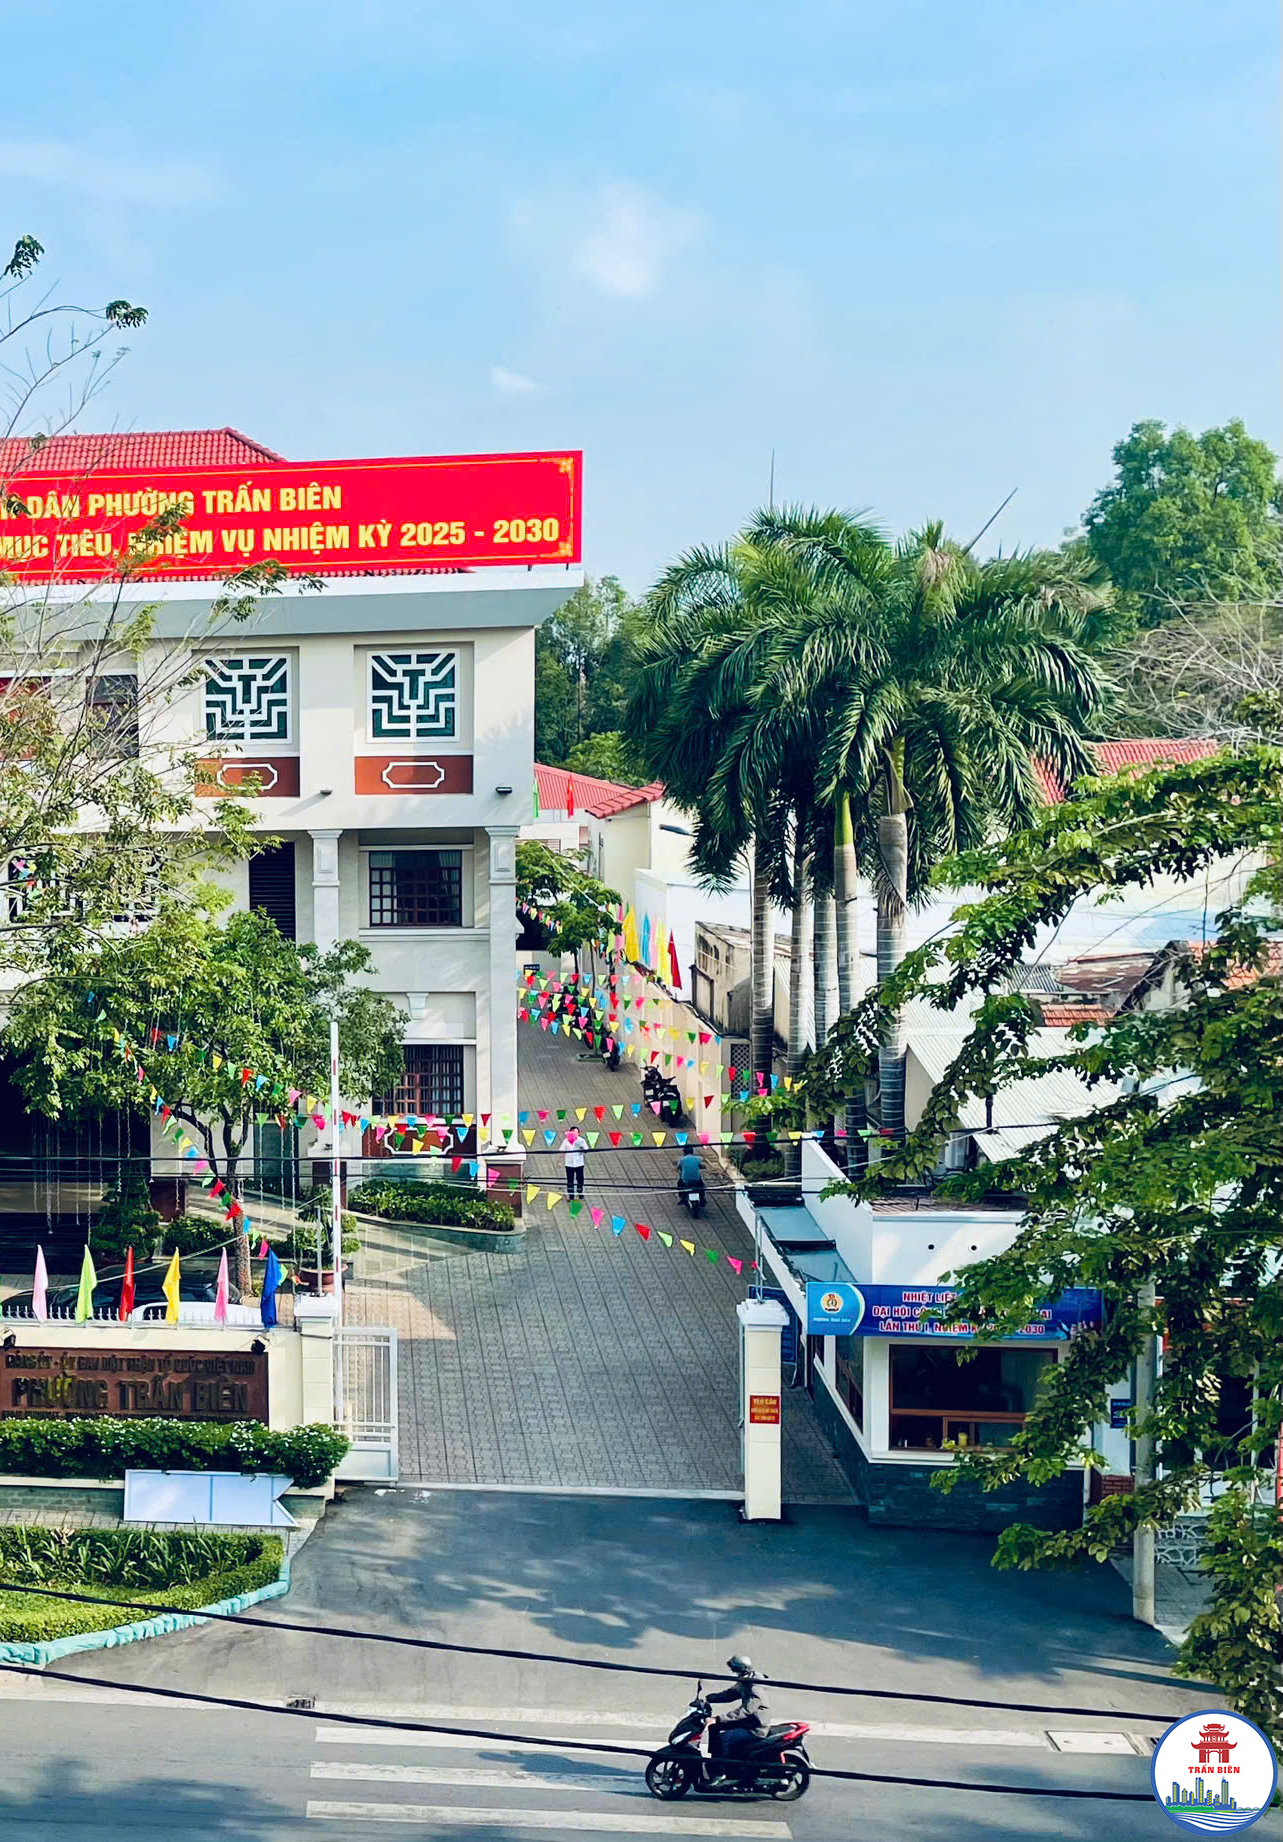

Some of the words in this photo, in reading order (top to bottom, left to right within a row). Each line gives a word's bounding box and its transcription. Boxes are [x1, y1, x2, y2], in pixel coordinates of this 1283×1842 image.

[26, 491, 81, 520] DÂN
[88, 487, 195, 517] PHƯỜNG
[202, 481, 272, 514] TRẤN
[280, 481, 342, 511] BIÊN
[55, 528, 119, 559] TIÊU,
[220, 528, 255, 558] VỤ
[262, 521, 350, 555] NHIỆM
[358, 519, 392, 549] KỲ
[400, 521, 466, 547] 2025
[492, 517, 560, 544] 2030
[892, 1304, 911, 1319] HỘI
[902, 1290, 933, 1304] NHIỆT
[12, 1371, 108, 1409] PHƯỜNG
[117, 1371, 184, 1411] TRẤN
[191, 1375, 248, 1412] BIÊN
